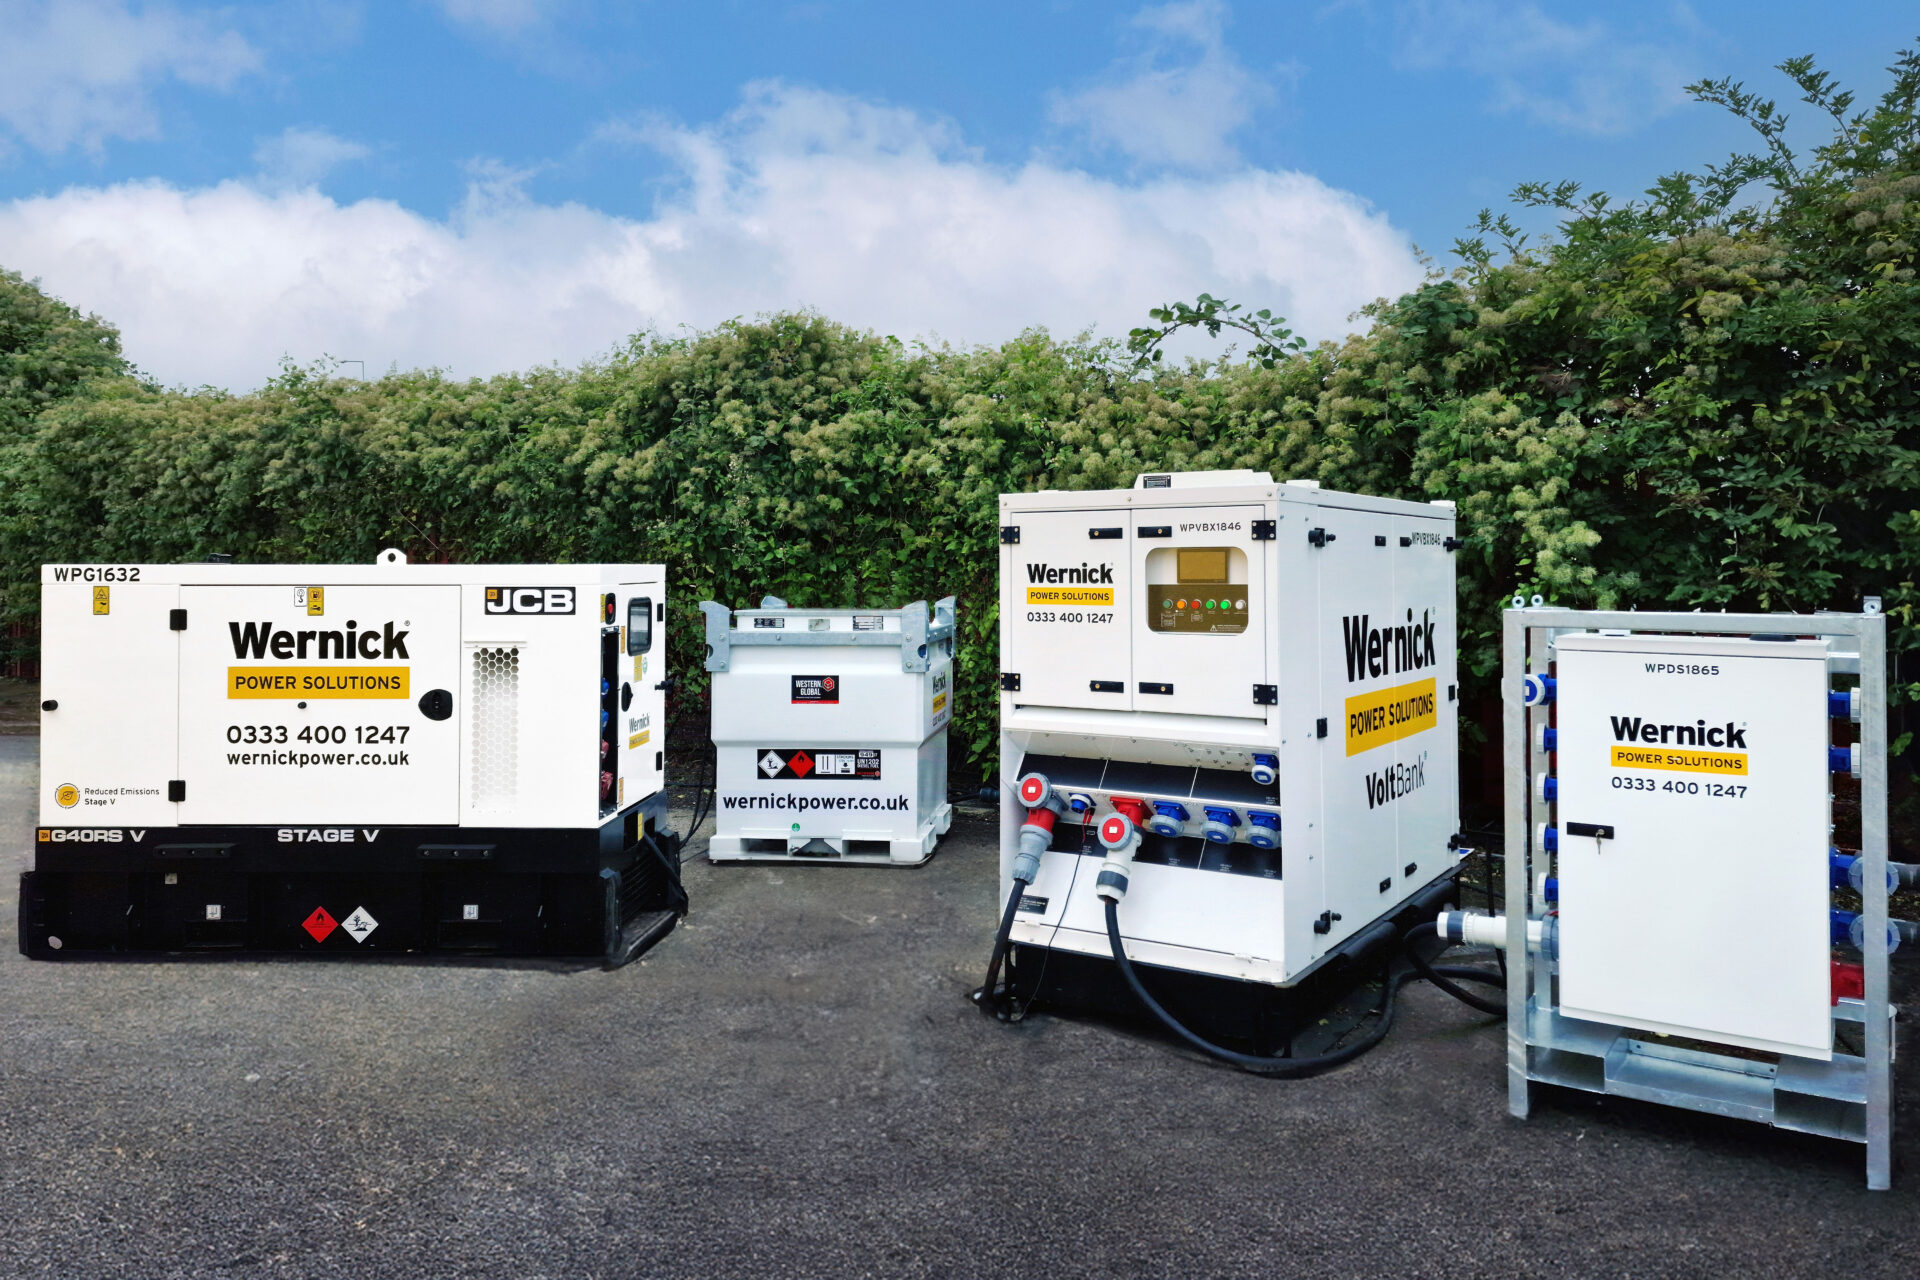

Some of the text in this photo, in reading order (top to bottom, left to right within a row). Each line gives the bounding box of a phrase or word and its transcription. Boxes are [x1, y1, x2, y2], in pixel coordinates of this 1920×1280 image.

[1179, 522, 1242, 532] WPVBX1846
[54, 567, 141, 582] WPG1632
[1026, 562, 1113, 584] Wernick
[487, 589, 574, 613] JCB
[1030, 591, 1110, 601] POWER SOLUTIONS
[1027, 611, 1113, 624] 0333 400 1247
[228, 619, 410, 660] Wernick
[1343, 608, 1436, 683] Wernick
[1645, 663, 1720, 676] WPDS1865
[235, 676, 401, 690] POWER SOLUTIONS
[795, 680, 822, 688] WESTERN
[800, 688, 821, 696] GLOBAL
[1350, 692, 1434, 738] POWER SOLUTIONS
[226, 725, 410, 744] 0333 400 1247
[1610, 715, 1747, 749] Wernick
[227, 750, 410, 768] wernickpower.co.uk
[1617, 751, 1743, 770] POWER SOLUTIONS
[1365, 754, 1425, 810] VoltBank
[1611, 776, 1748, 799] 0333 400 1247
[84, 788, 161, 796] Reduced Emissions
[84, 798, 117, 807] Stage V
[722, 793, 910, 813] wernickpower.co.uk
[129, 829, 147, 842] V
[277, 829, 380, 843] STAGE V
